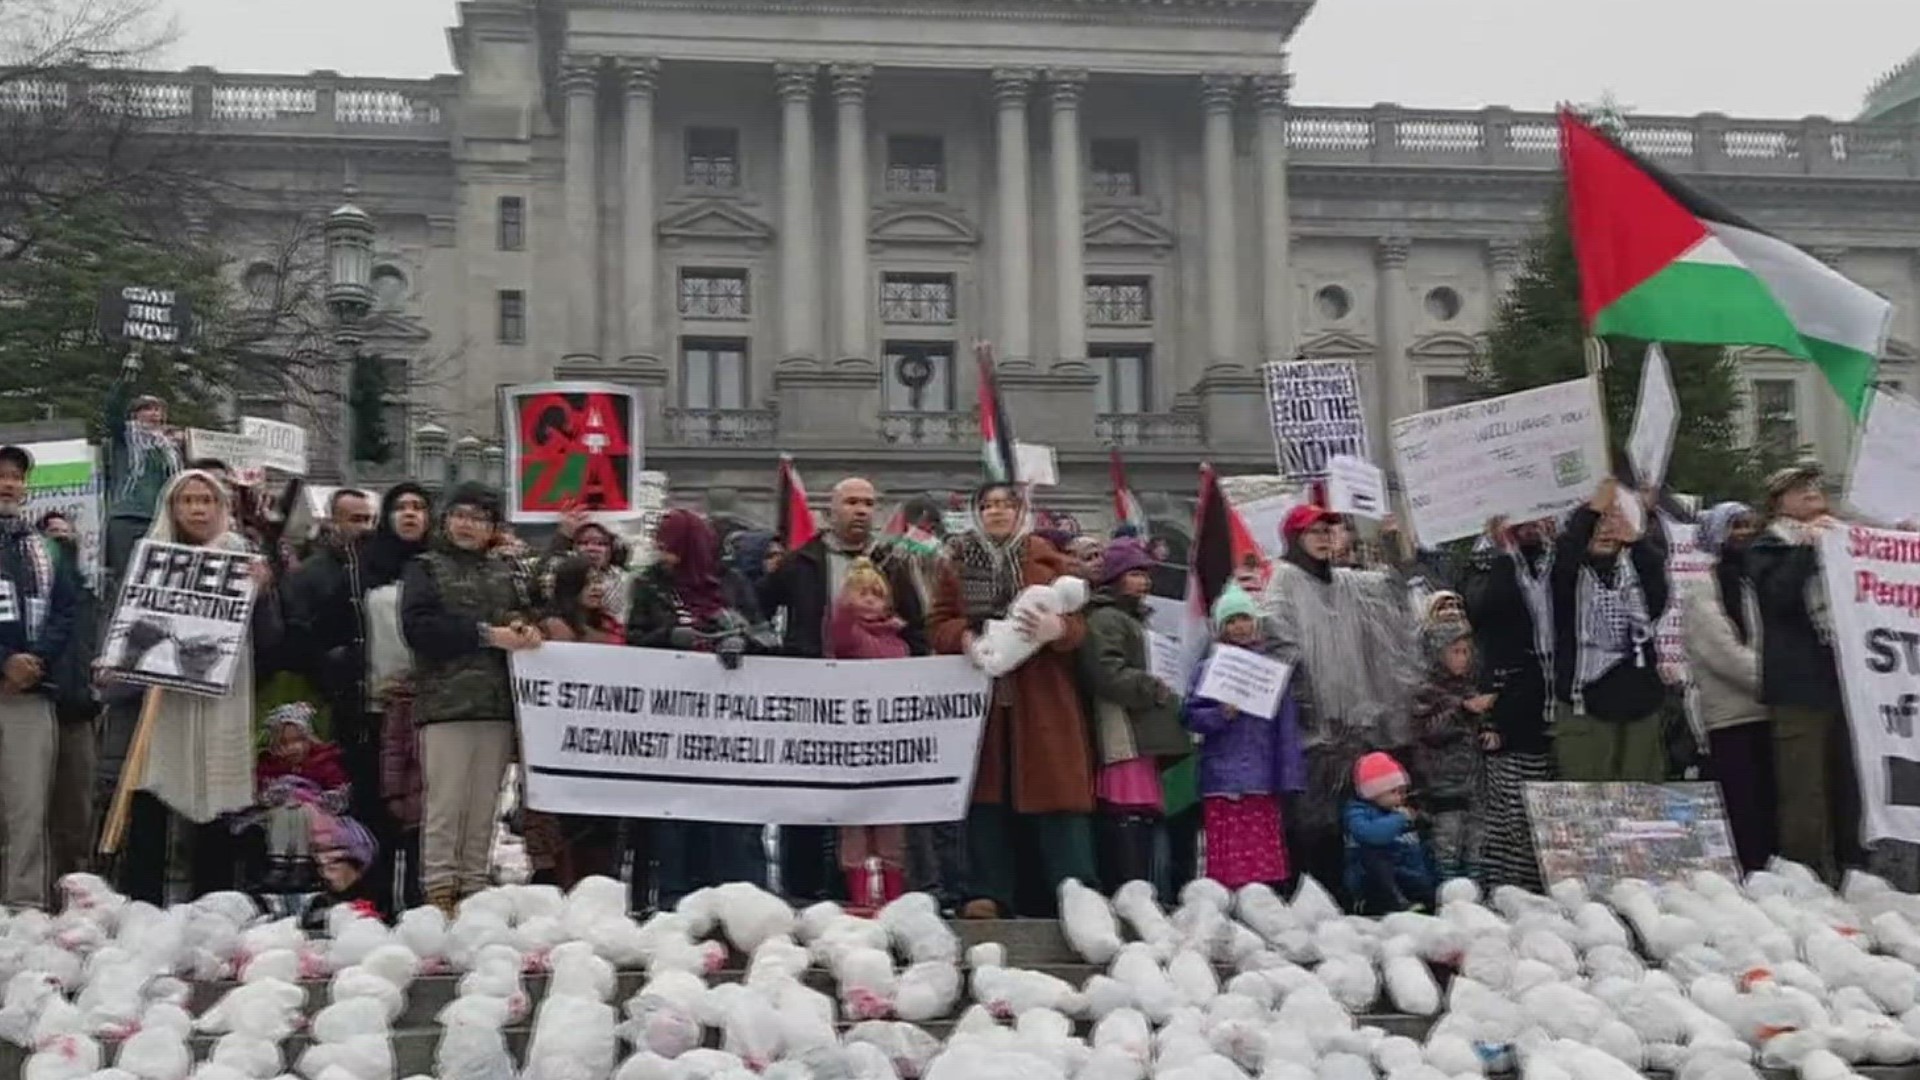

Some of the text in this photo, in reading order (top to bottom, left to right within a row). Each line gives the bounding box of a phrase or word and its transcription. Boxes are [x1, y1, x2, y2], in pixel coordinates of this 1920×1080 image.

[140, 546, 252, 597] FREE
[126, 582, 250, 623] PALESTINE
[516, 677, 987, 725] WE STAND WITH PALESTINE & LEBANON
[560, 724, 938, 767] AGAINST ISRAELI AGGRESSION!
